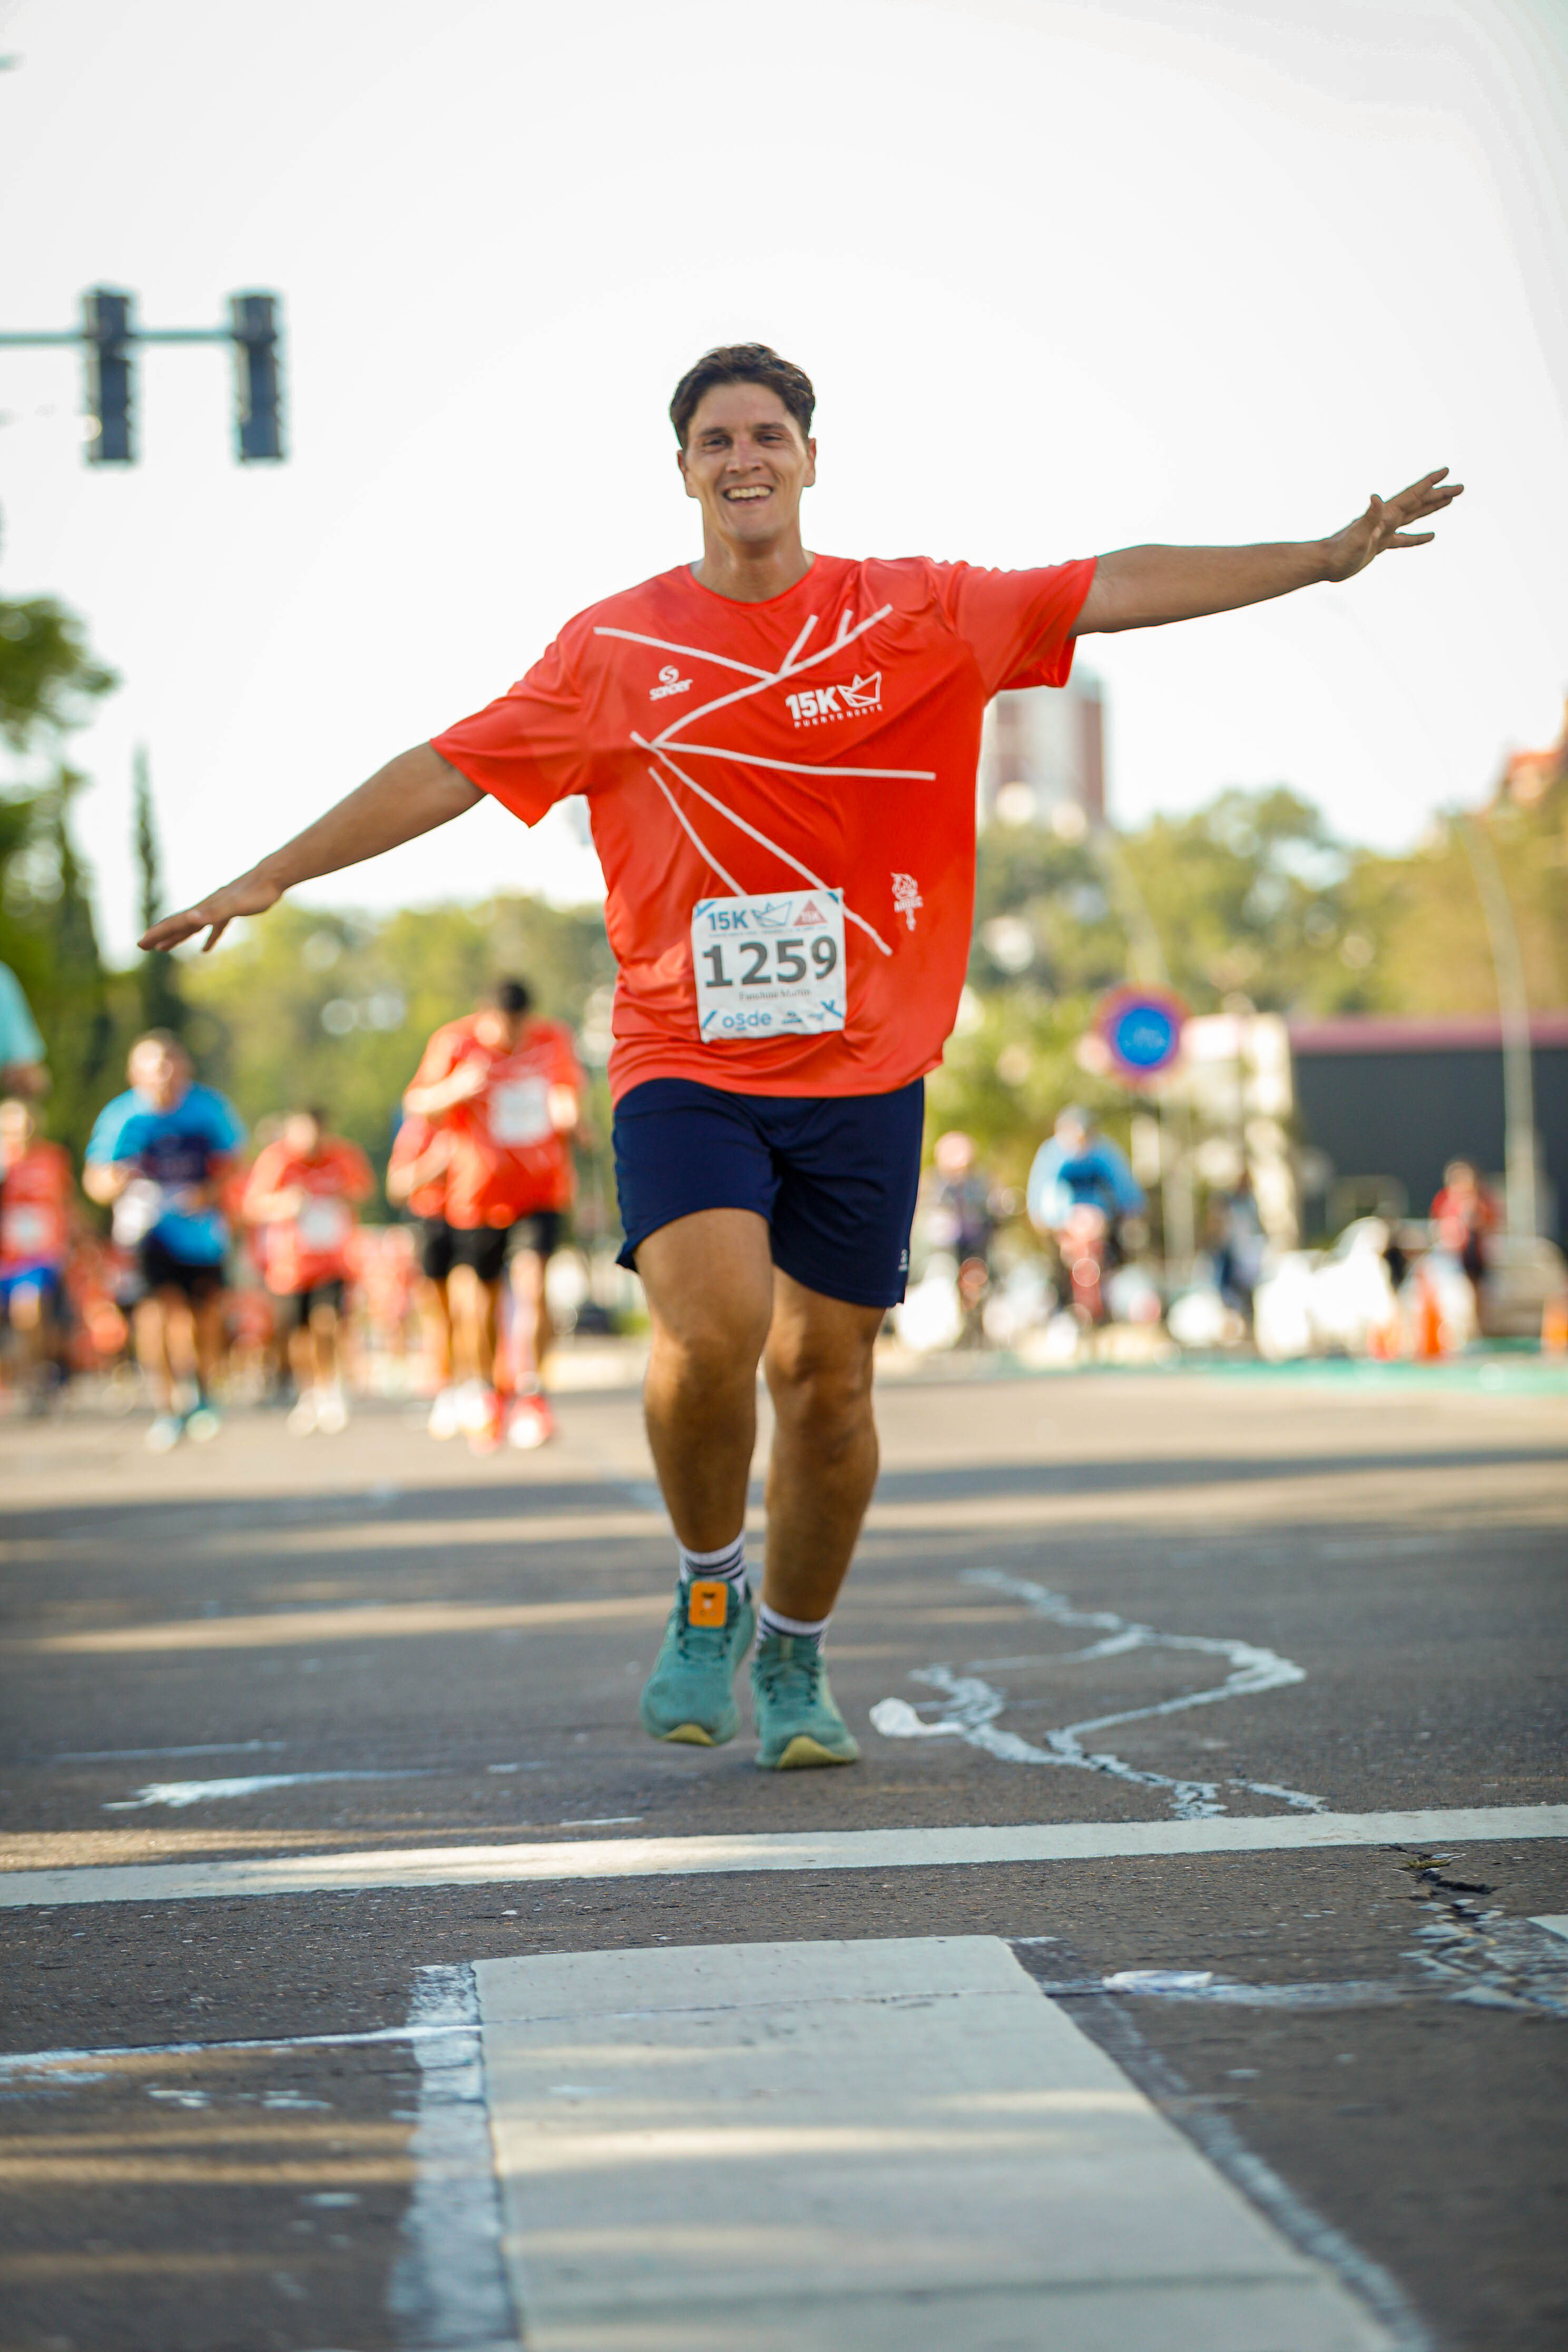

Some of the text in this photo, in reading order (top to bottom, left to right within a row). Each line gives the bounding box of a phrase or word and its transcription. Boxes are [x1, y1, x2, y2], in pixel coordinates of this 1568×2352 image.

[785, 686, 842, 720] 15K
[794, 703, 883, 729] PUERTO NORTE
[707, 909, 749, 931] 15K
[702, 935, 837, 988] 1259
